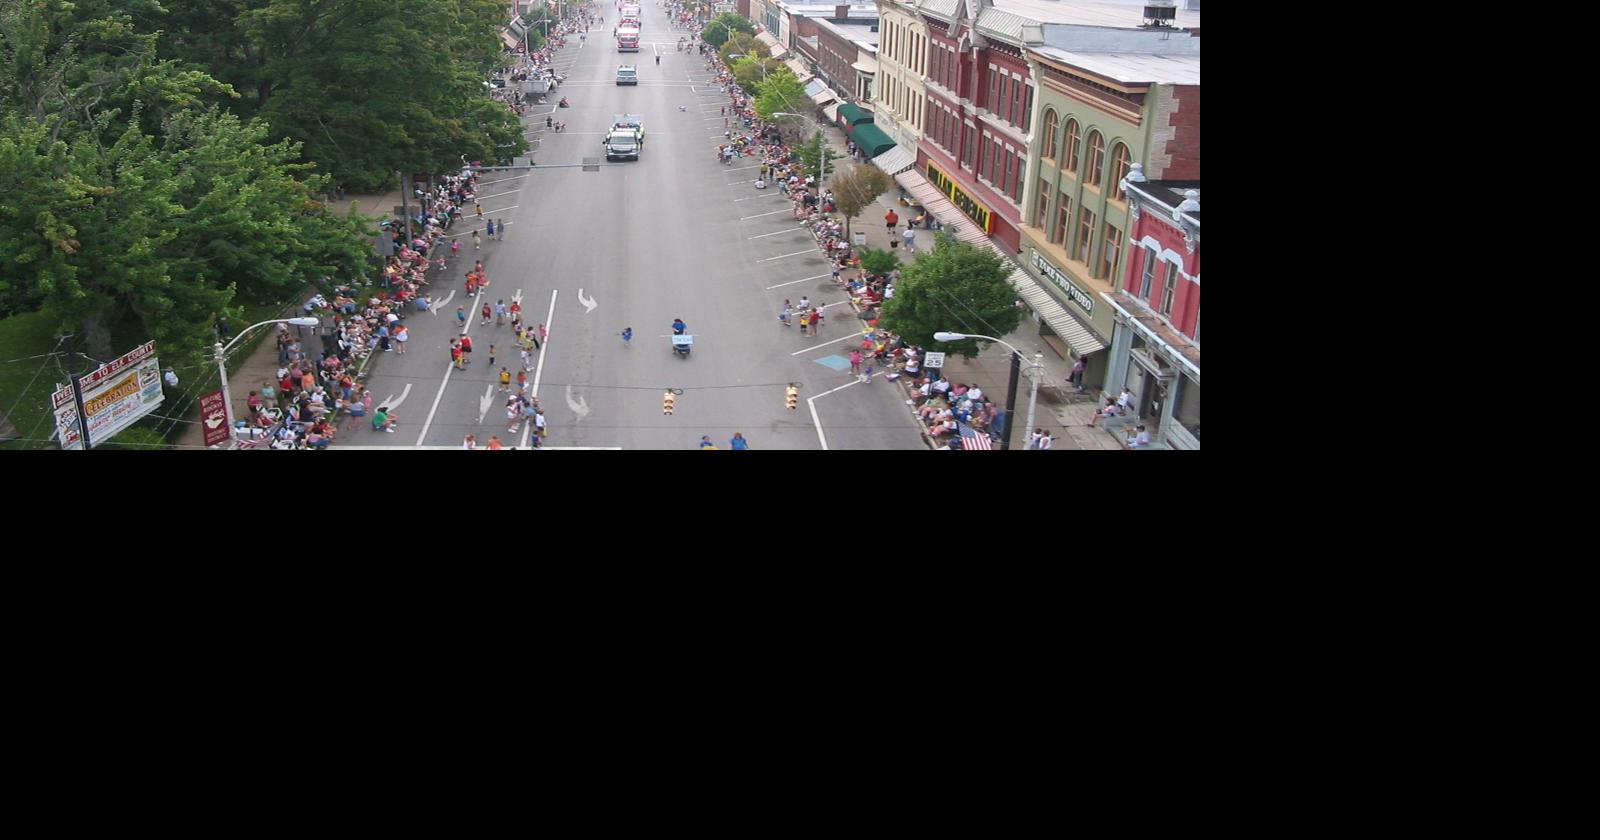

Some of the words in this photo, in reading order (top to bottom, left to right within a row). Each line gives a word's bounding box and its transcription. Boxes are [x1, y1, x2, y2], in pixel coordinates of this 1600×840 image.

[1039, 259, 1055, 279] TAKE
[1056, 273, 1070, 291] TWO
[1070, 286, 1092, 311] VIDEO
[99, 367, 108, 377] TO
[112, 359, 126, 371] ELK
[128, 343, 154, 361] COUNTY
[85, 380, 137, 417] CELEBRATION
